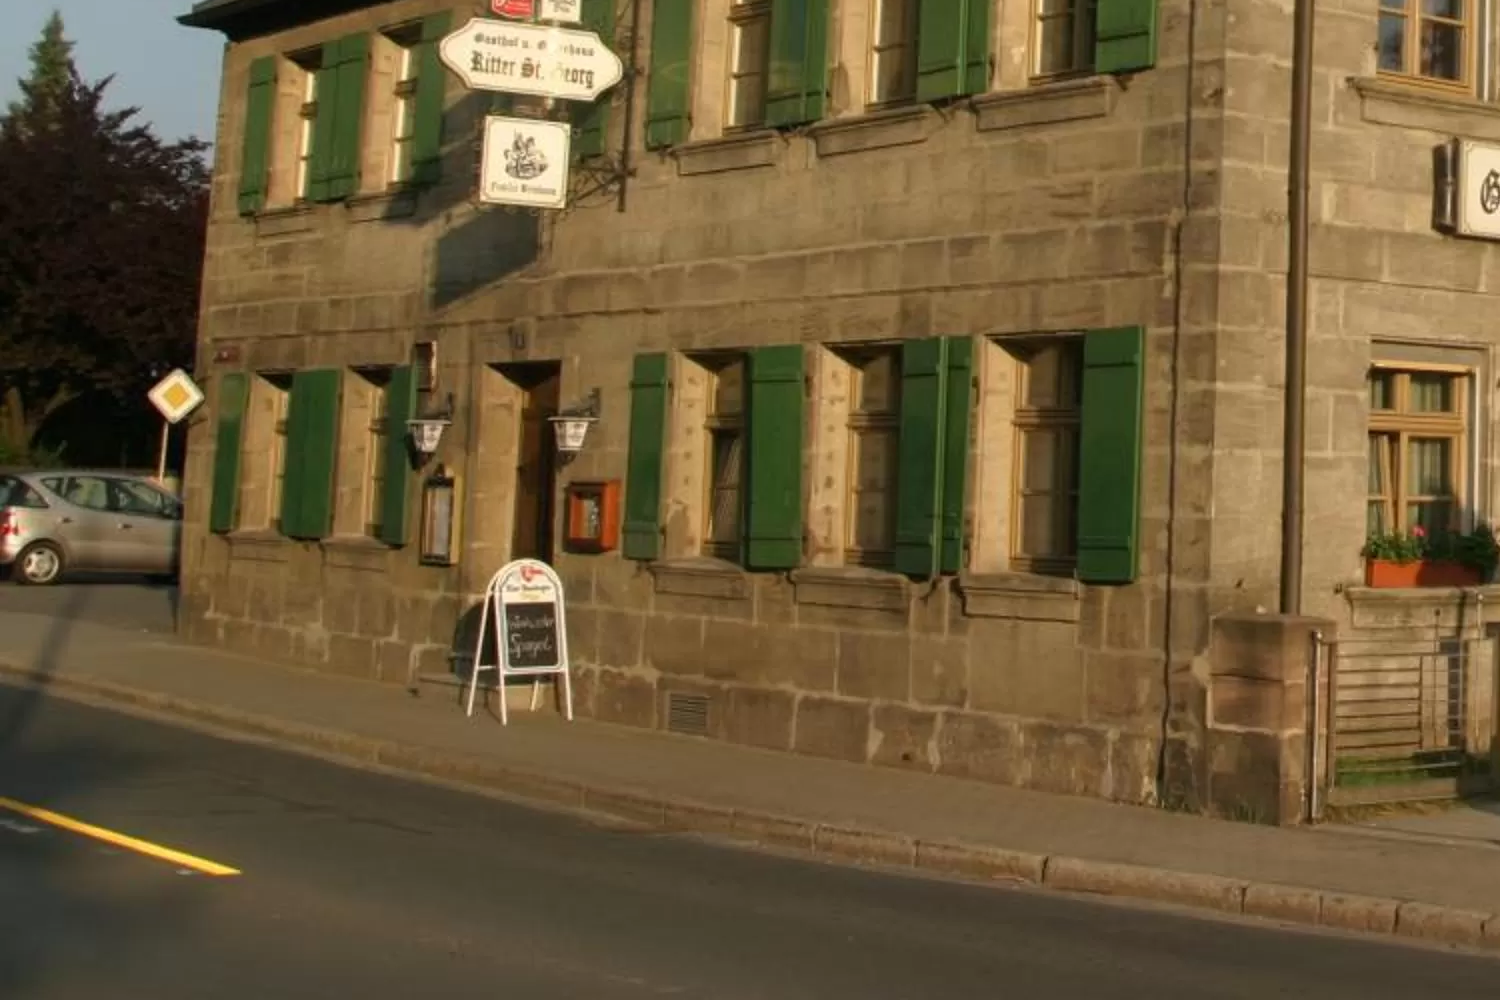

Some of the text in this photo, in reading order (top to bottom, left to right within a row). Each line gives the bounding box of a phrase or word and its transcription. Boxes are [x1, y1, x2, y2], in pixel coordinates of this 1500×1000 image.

[470, 51, 596, 89] Ritter St. eorg
